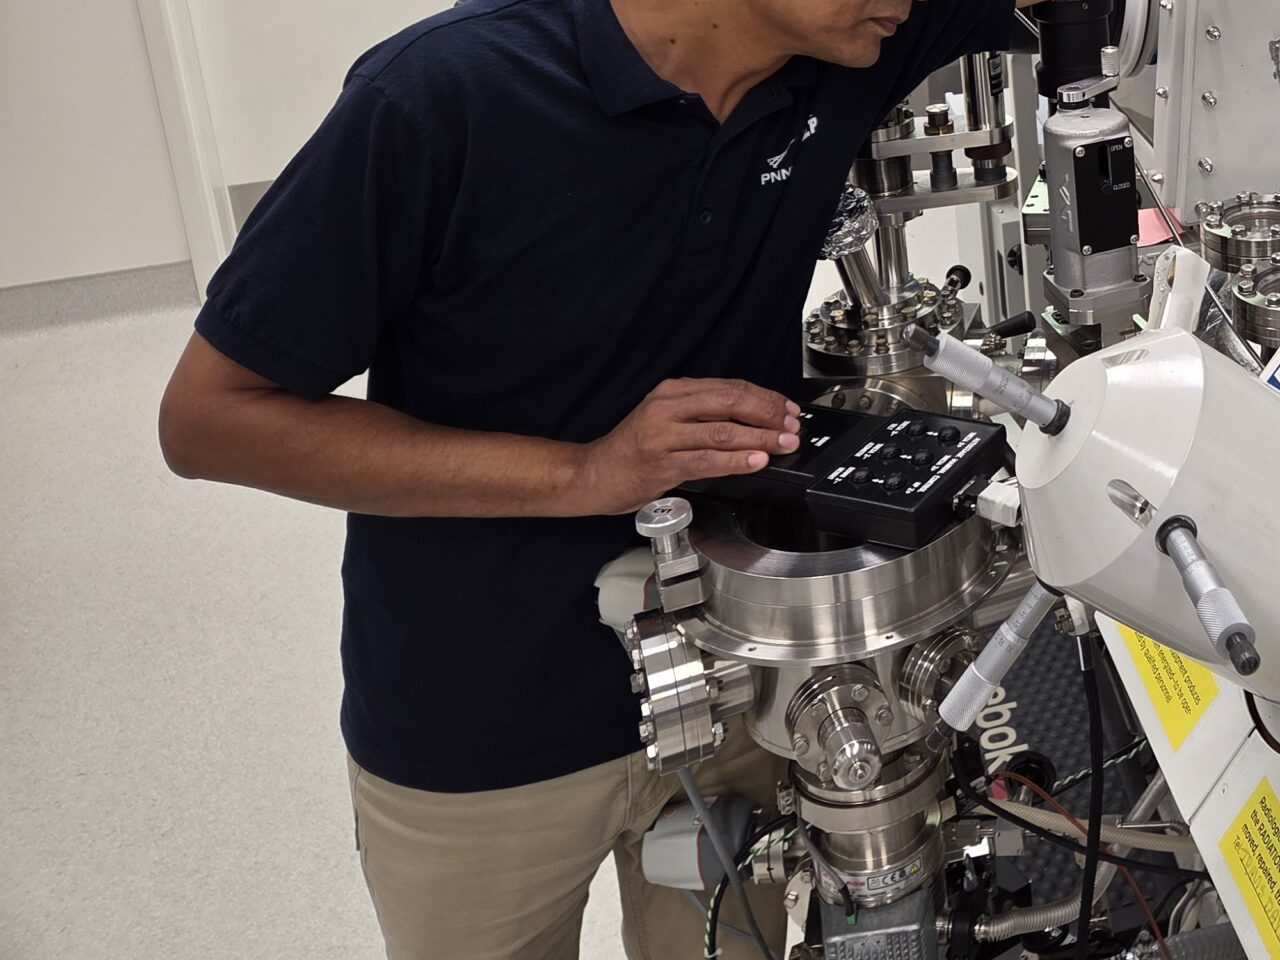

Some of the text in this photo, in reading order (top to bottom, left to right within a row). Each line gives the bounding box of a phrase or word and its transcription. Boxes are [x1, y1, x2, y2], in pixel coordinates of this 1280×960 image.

[1110, 144, 1123, 152] OPEN
[1113, 182, 1130, 191] CLOSED
[1144, 648, 1159, 675] qualified
[1155, 673, 1172, 704] personnel
[1184, 675, 1201, 706] produces
[1250, 809, 1260, 827] the
[1241, 823, 1259, 856] moved,
[1256, 853, 1277, 894] repaired,
